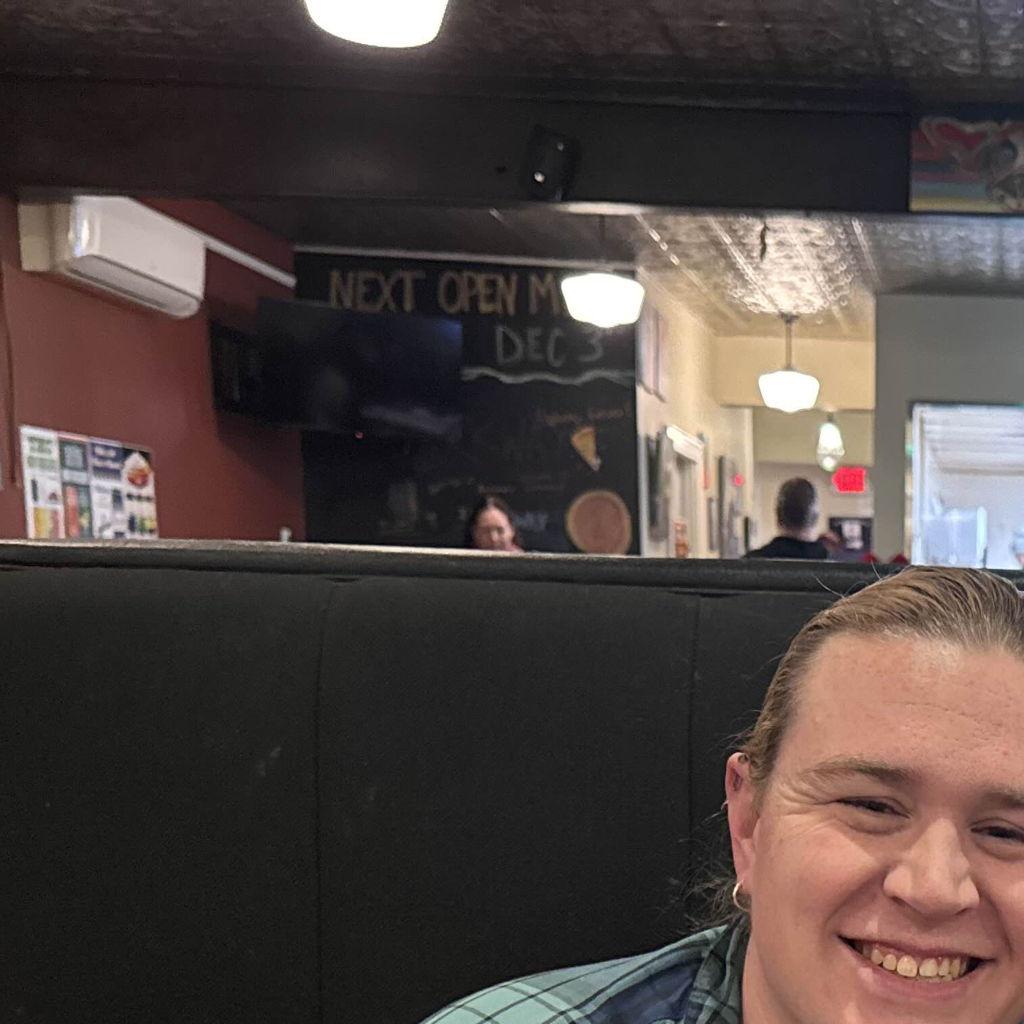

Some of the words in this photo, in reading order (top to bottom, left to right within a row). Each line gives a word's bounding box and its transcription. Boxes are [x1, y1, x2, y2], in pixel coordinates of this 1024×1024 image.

[329, 269, 426, 313] NEXT
[437, 270, 518, 316] OPEN
[495, 324, 566, 367] DEC
